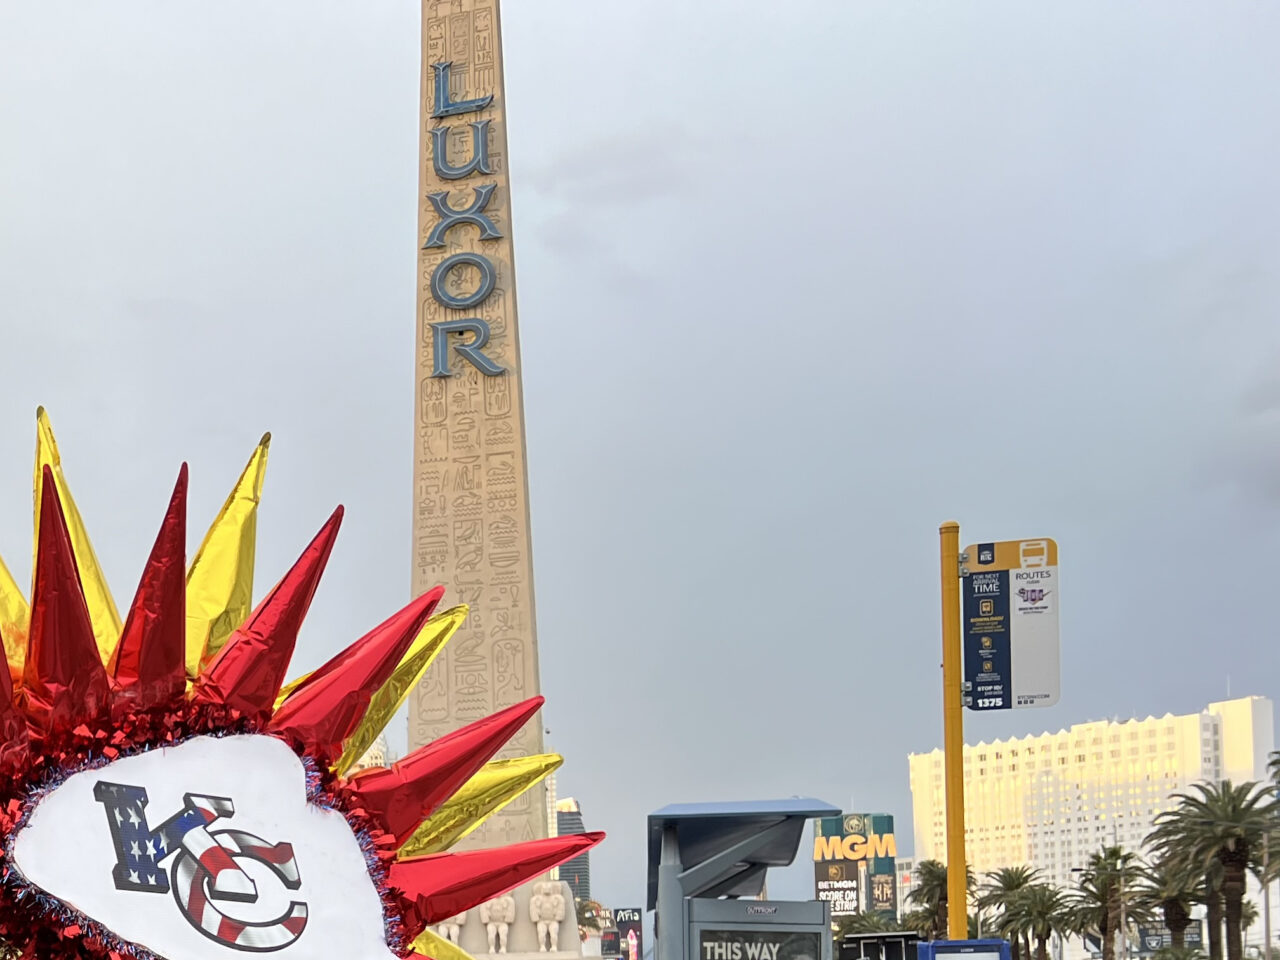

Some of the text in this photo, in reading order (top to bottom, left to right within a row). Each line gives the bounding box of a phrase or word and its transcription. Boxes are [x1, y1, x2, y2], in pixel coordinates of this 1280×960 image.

[421, 60, 504, 378] LUXOR
[1016, 570, 1052, 580] ROUTES
[973, 584, 1000, 593] TIME
[977, 698, 1003, 707] 1375
[813, 834, 897, 860] MGM
[93, 780, 309, 953] KC
[818, 880, 857, 889] BETMGM
[818, 890, 857, 901] SCORE ON
[835, 900, 857, 911] STRIP
[703, 942, 780, 960] THIS WAY
